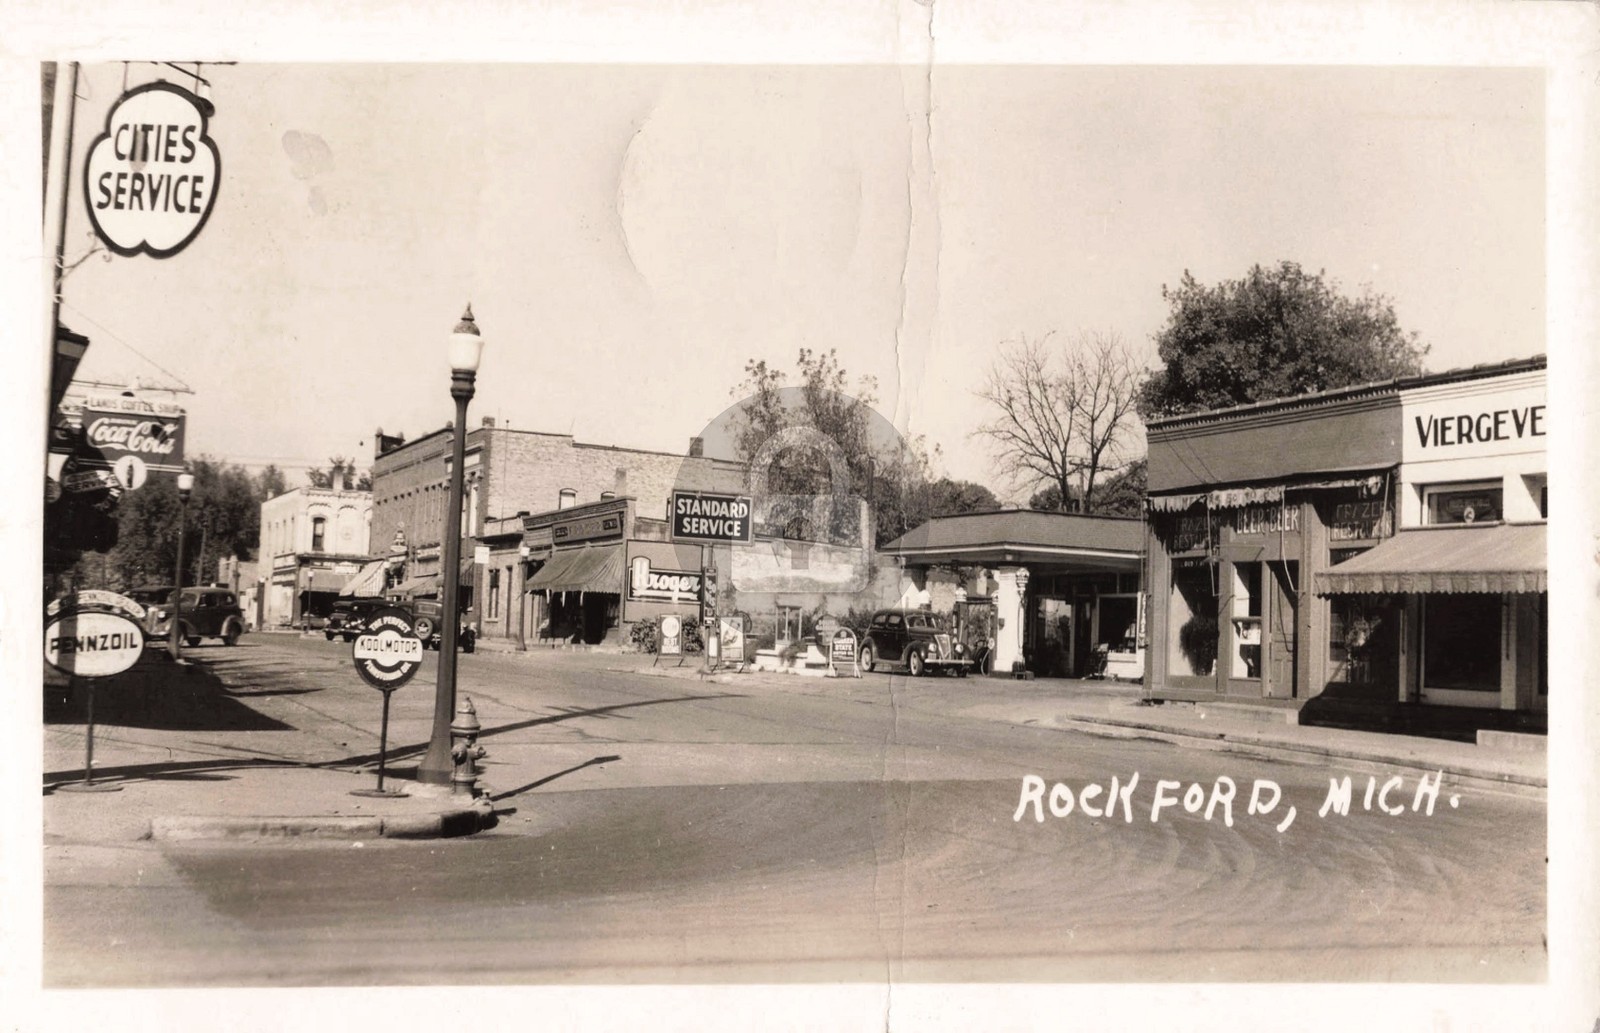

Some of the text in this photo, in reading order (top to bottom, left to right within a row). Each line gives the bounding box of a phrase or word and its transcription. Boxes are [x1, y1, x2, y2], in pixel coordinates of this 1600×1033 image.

[114, 123, 197, 164] CITIES
[96, 171, 205, 214] SERVICE
[1414, 404, 1547, 449] VIERGEVE
[676, 498, 749, 519] STANDARD
[1236, 504, 1301, 535] BEER BEER
[681, 516, 742, 537] SERVICE
[630, 556, 702, 604] Kroger
[50, 632, 138, 655] PENNZOIL
[360, 637, 418, 654] KOOLMOTOR
